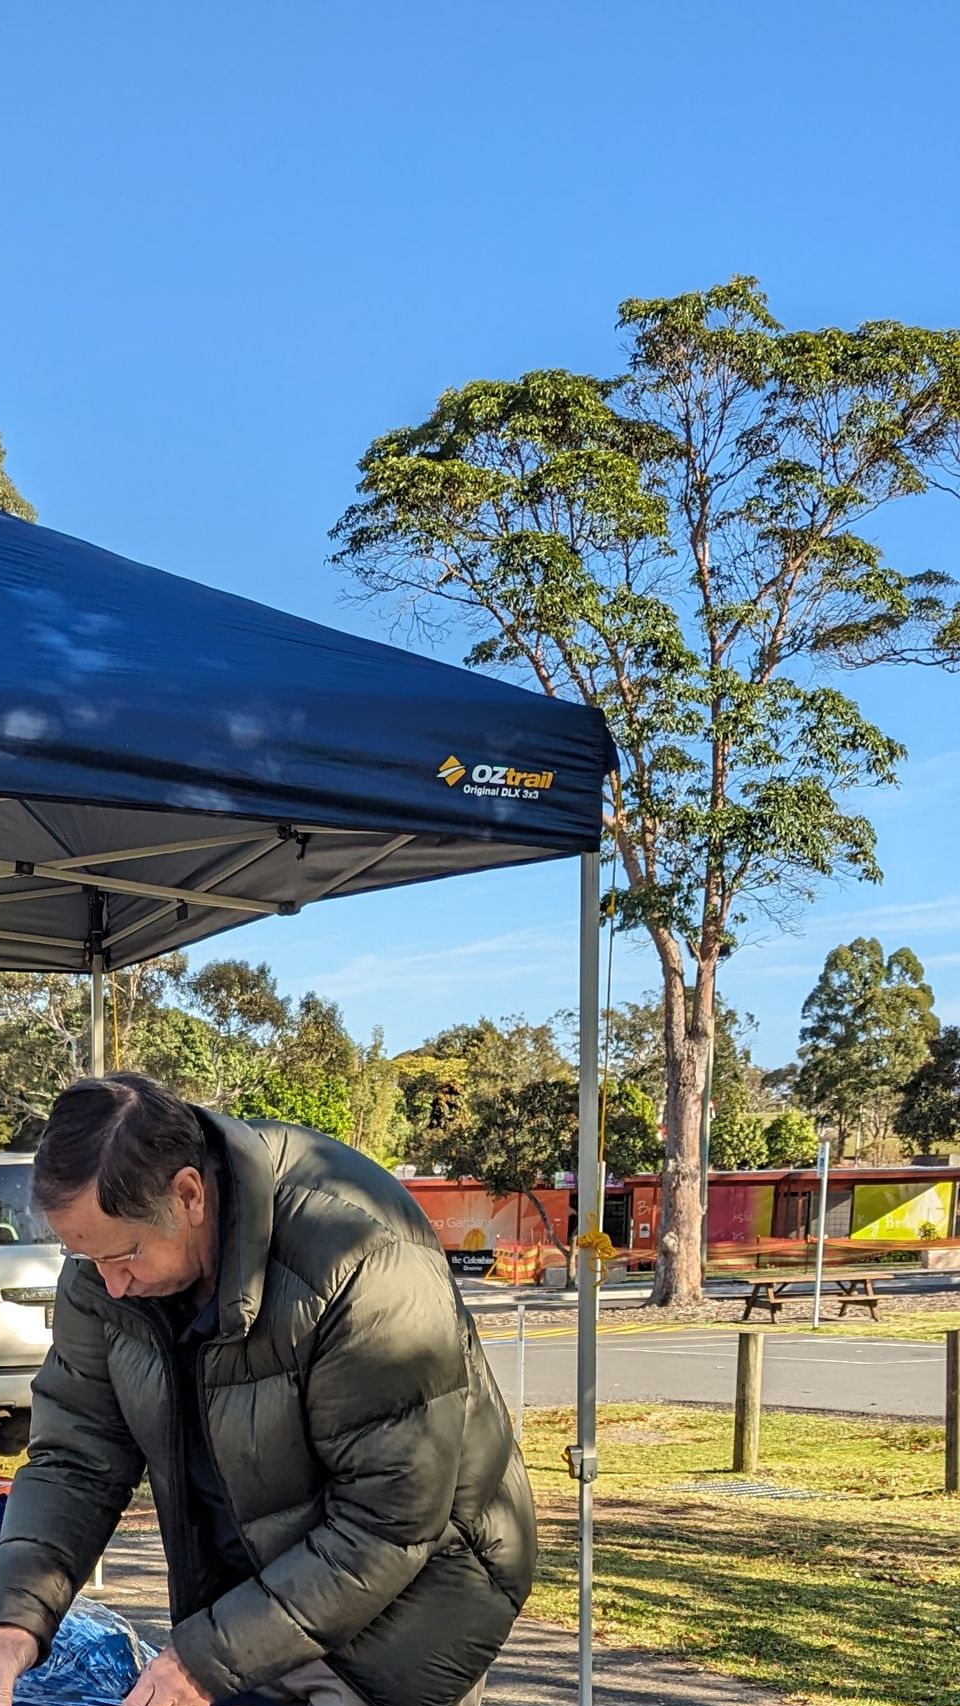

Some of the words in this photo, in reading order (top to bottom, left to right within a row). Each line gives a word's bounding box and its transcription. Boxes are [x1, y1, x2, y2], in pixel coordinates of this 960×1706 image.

[472, 764, 553, 789] OZtrail
[463, 784, 499, 797] Original
[501, 787, 520, 798] DLX
[522, 789, 539, 800] 3x3
